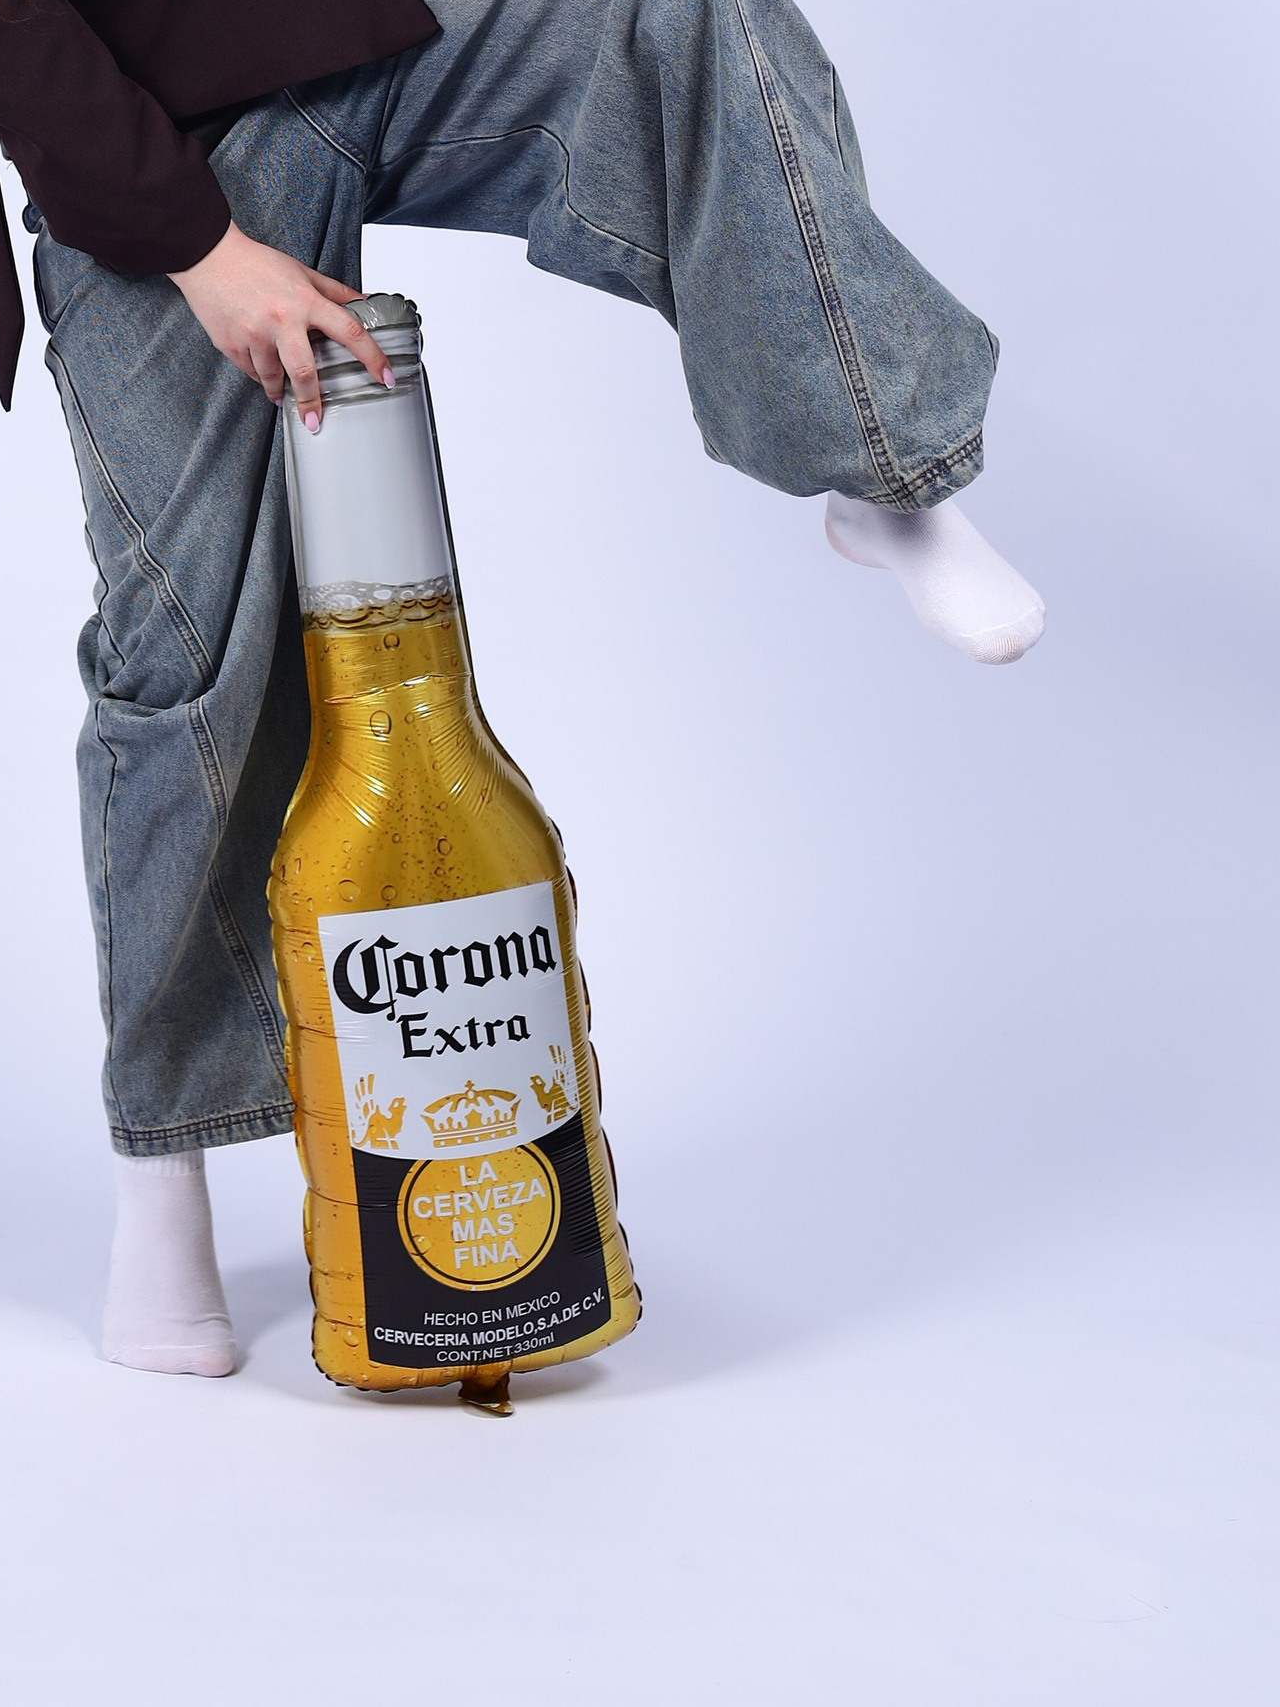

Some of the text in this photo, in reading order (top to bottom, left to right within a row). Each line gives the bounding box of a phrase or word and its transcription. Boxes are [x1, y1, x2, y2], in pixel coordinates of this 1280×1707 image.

[333, 924, 558, 1021] Corona
[396, 1011, 532, 1059] Extra
[458, 1160, 498, 1187] LA
[412, 1177, 547, 1219] CERVEZA
[452, 1213, 515, 1243] MAS
[453, 1240, 521, 1270] FINA
[373, 1327, 470, 1347] CERVECERIA
[582, 1287, 605, 1311] C.V.
[423, 1291, 561, 1326] HECHO EN MEXICO
